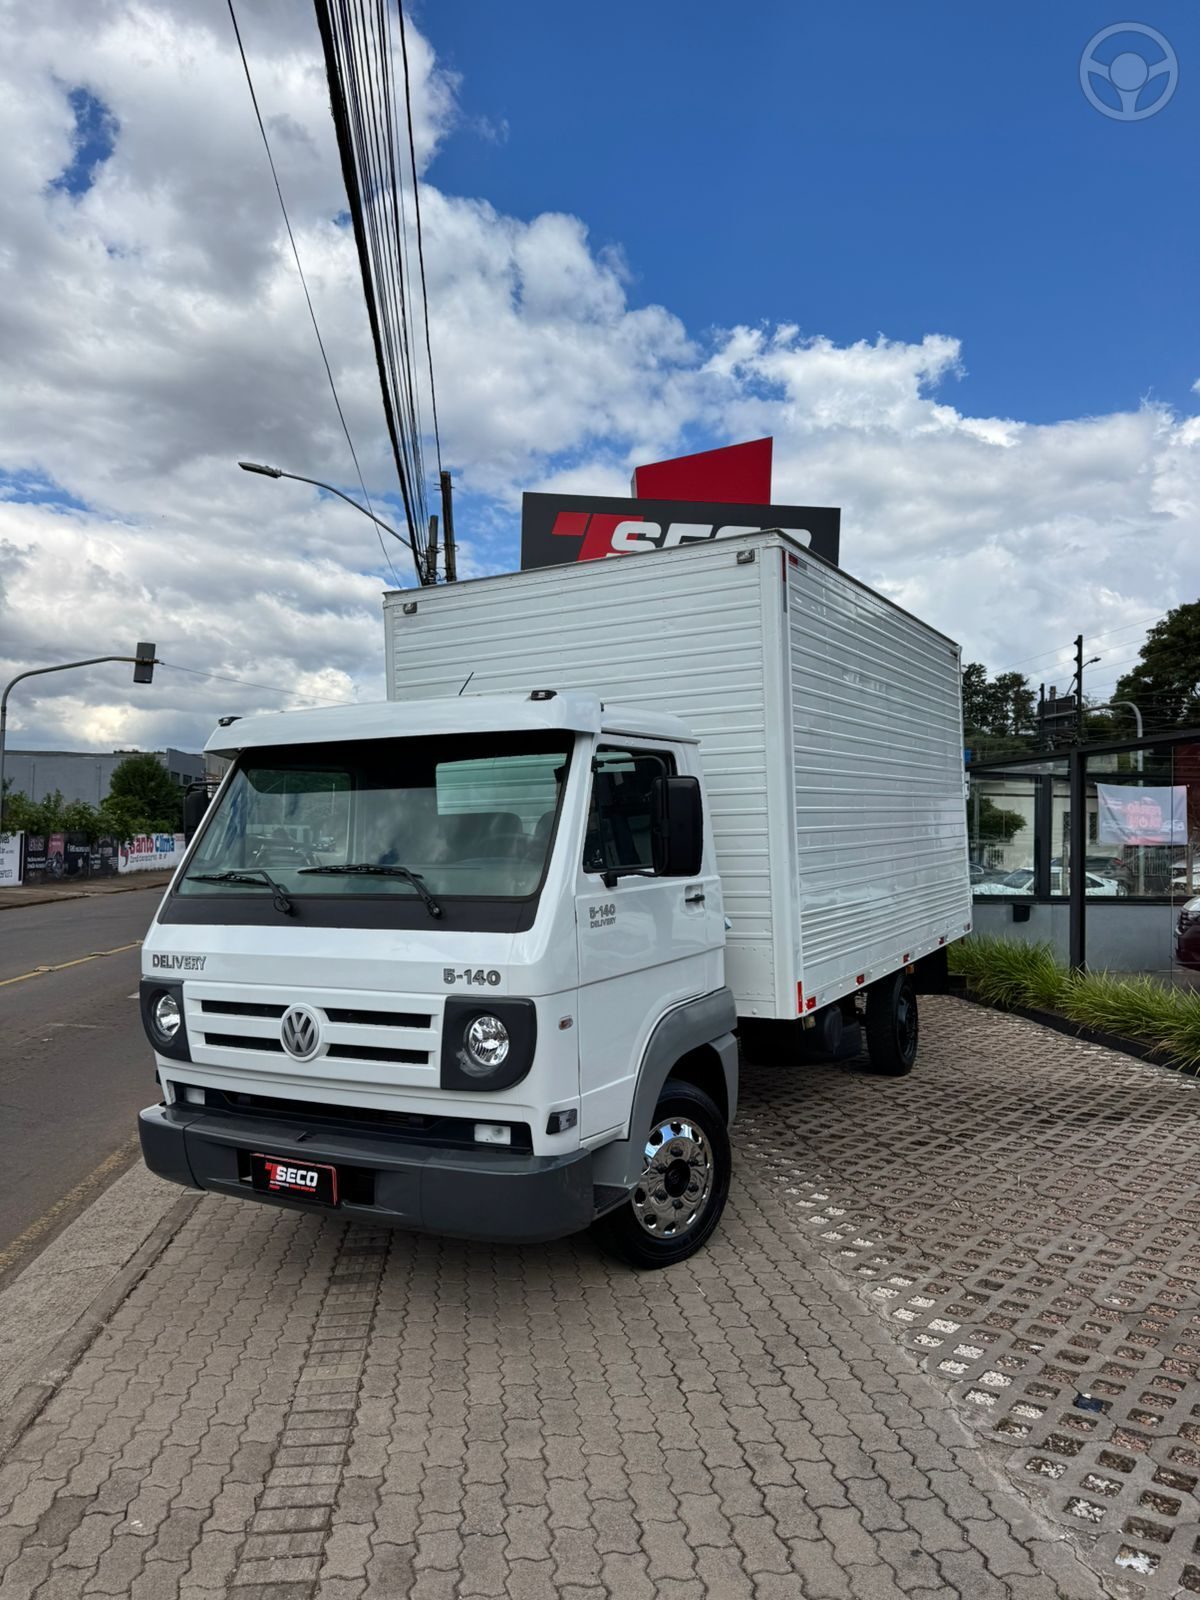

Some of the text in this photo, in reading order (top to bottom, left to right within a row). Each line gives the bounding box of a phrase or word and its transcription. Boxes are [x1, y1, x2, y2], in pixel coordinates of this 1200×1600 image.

[589, 903, 616, 919] 5-140
[590, 917, 616, 928] DELIVERY
[152, 954, 207, 970] DELIVERY
[443, 968, 501, 986] 5-140
